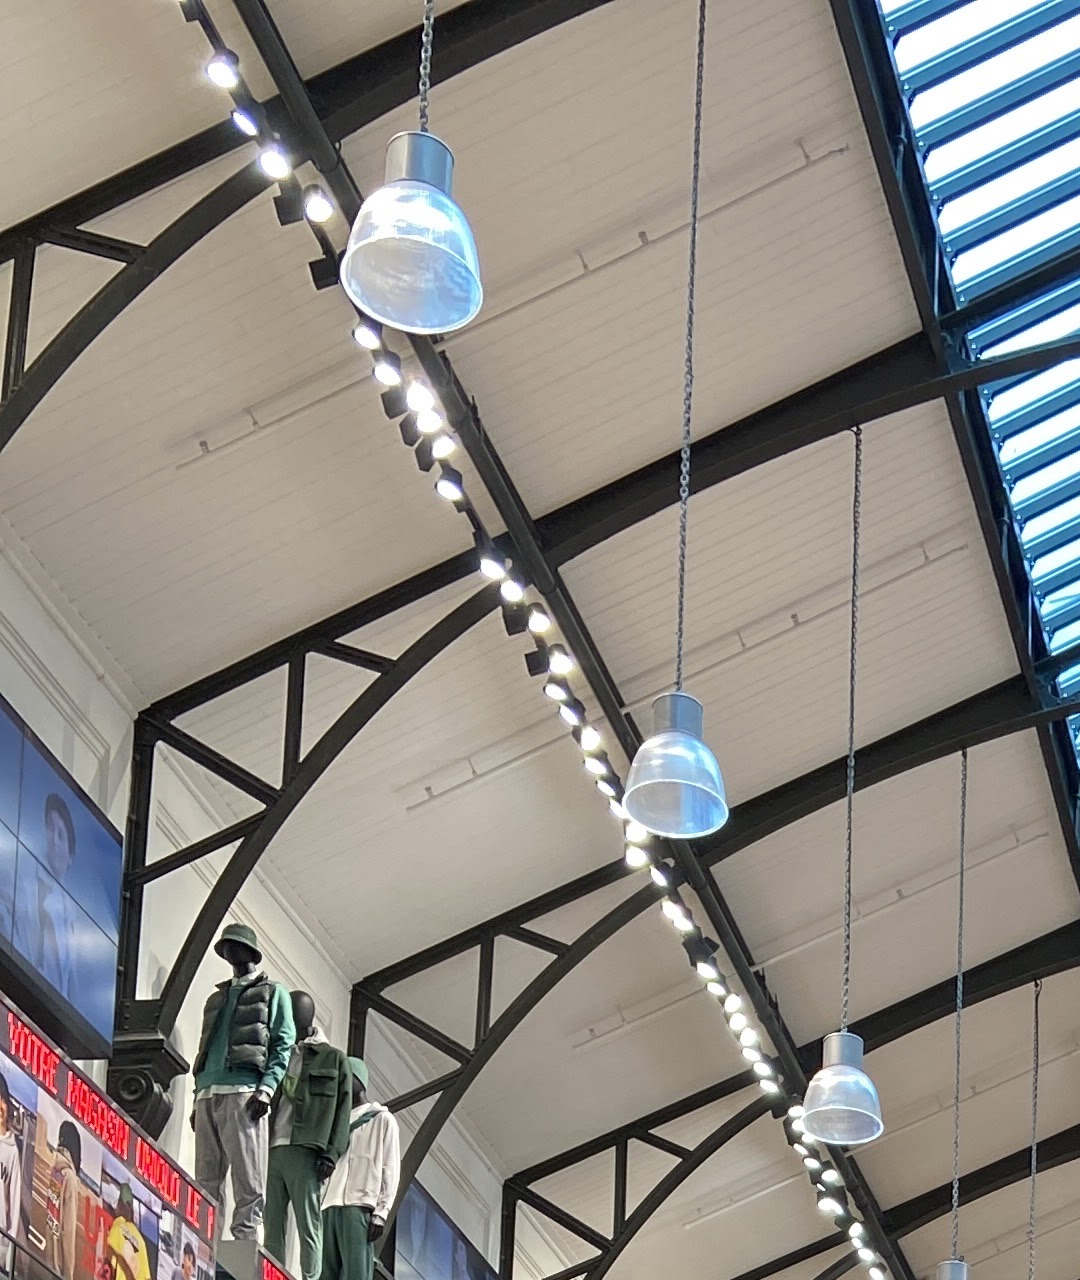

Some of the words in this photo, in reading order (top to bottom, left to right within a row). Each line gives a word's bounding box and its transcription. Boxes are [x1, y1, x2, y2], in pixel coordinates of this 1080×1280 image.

[8, 1012, 60, 1095] VOTRE
[66, 1070, 130, 1161] MAGASIN
[135, 1136, 181, 1208] UNIQLO
[186, 1185, 202, 1229] LE
